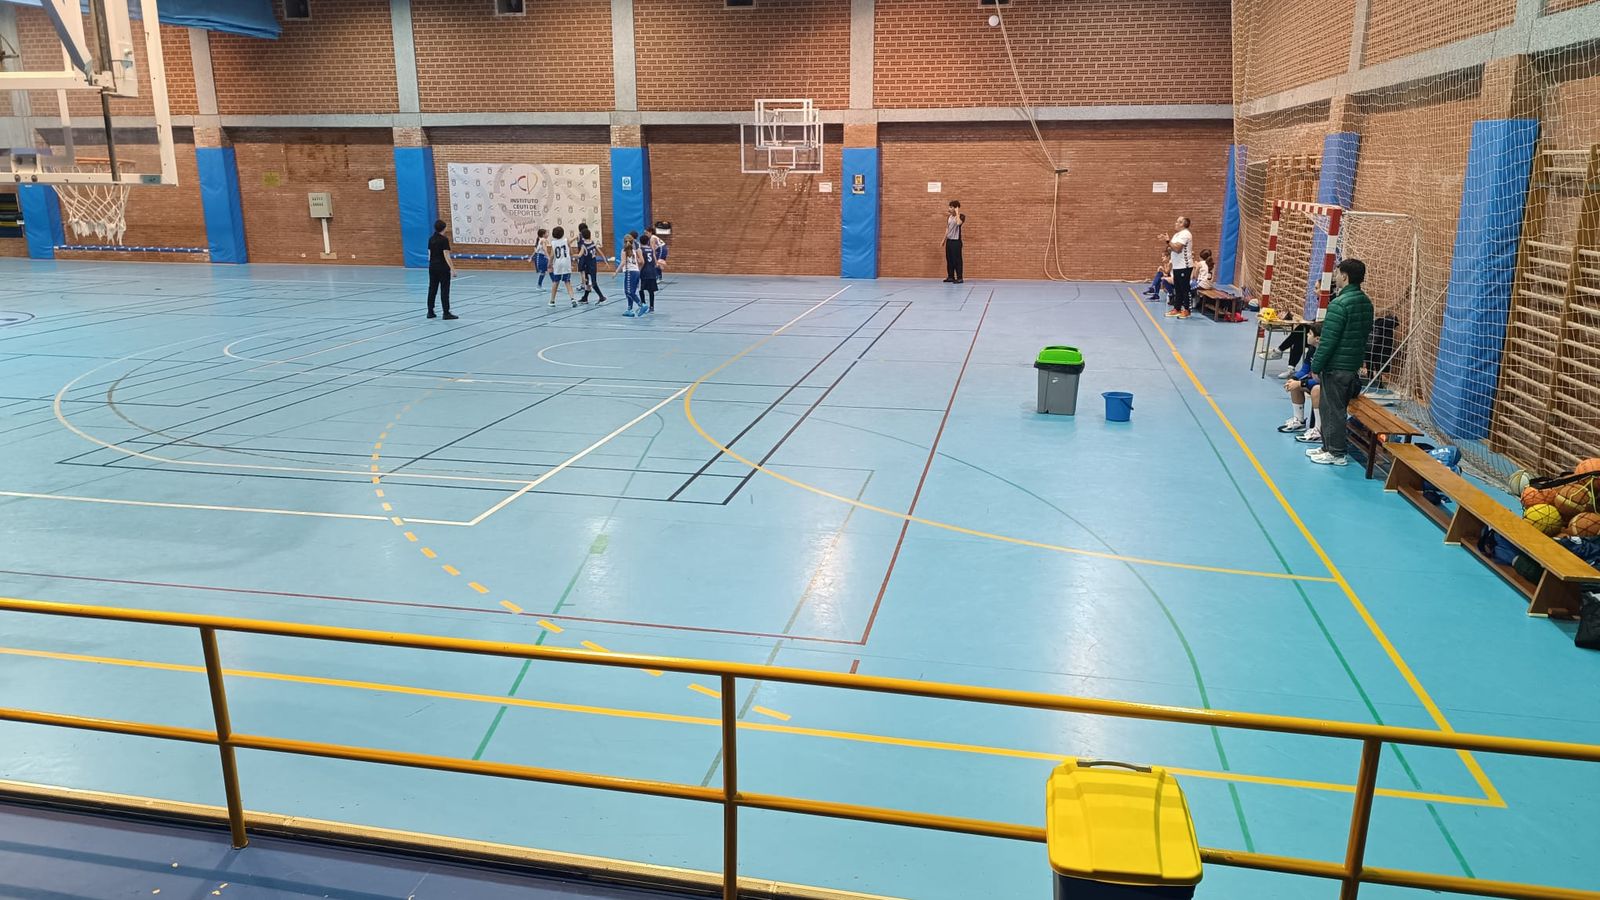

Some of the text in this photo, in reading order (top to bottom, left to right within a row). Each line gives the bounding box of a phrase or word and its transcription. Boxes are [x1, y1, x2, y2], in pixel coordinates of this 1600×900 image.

[454, 236, 535, 245] CIUDAD AUTÓNO
[647, 252, 653, 263] 5
